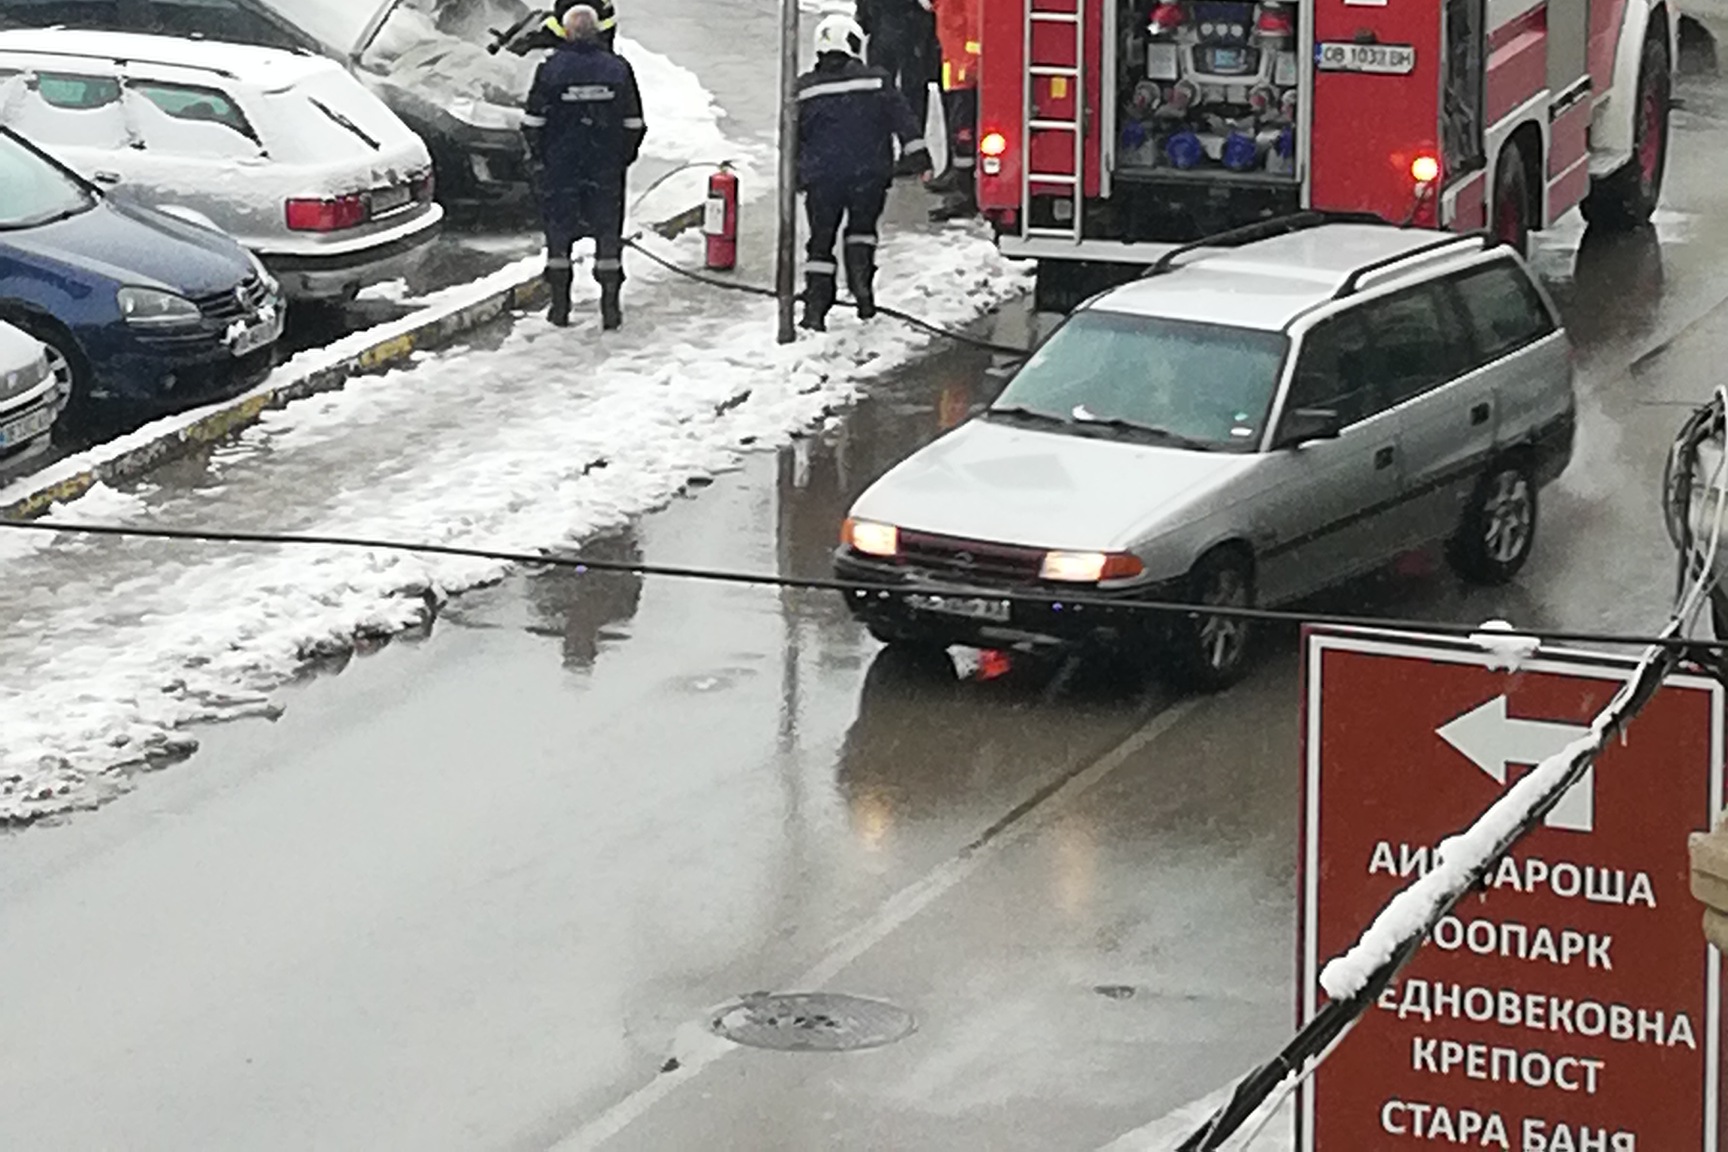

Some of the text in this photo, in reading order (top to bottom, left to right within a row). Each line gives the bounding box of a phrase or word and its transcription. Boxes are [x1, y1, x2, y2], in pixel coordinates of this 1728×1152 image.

[1484, 856, 1657, 908] АРОША
[1421, 915, 1612, 970] ООПАРК
[1377, 979, 1696, 1050] ЕДНОВЕКОВНА
[1412, 1036, 1605, 1094] КРЕПОСТ
[1381, 1100, 1636, 1152] СТАРА БАНЯ
